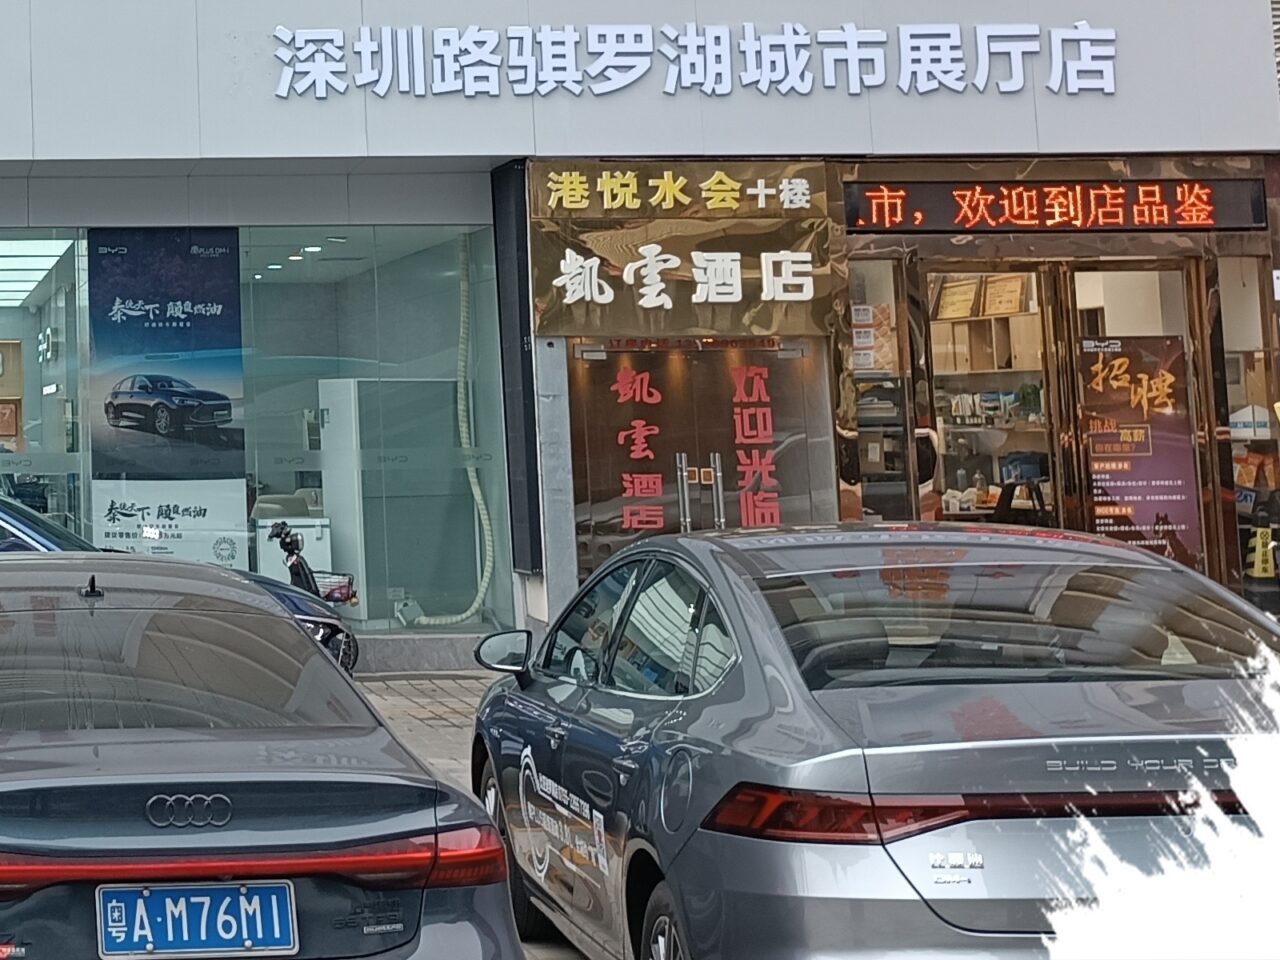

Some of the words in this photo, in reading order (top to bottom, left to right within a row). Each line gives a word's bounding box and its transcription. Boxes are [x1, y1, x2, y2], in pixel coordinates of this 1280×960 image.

[272, 20, 1119, 98] 深圳路骐罗湖城市展厅店
[547, 170, 742, 210] 港悦水会
[746, 178, 811, 209] 十楼
[98, 246, 128, 254] BYD
[1087, 351, 1176, 421] 招聘
[731, 366, 781, 529] 欢迎光临
[1046, 760, 1117, 771] BUILD
[1128, 759, 1193, 771] YOUR
